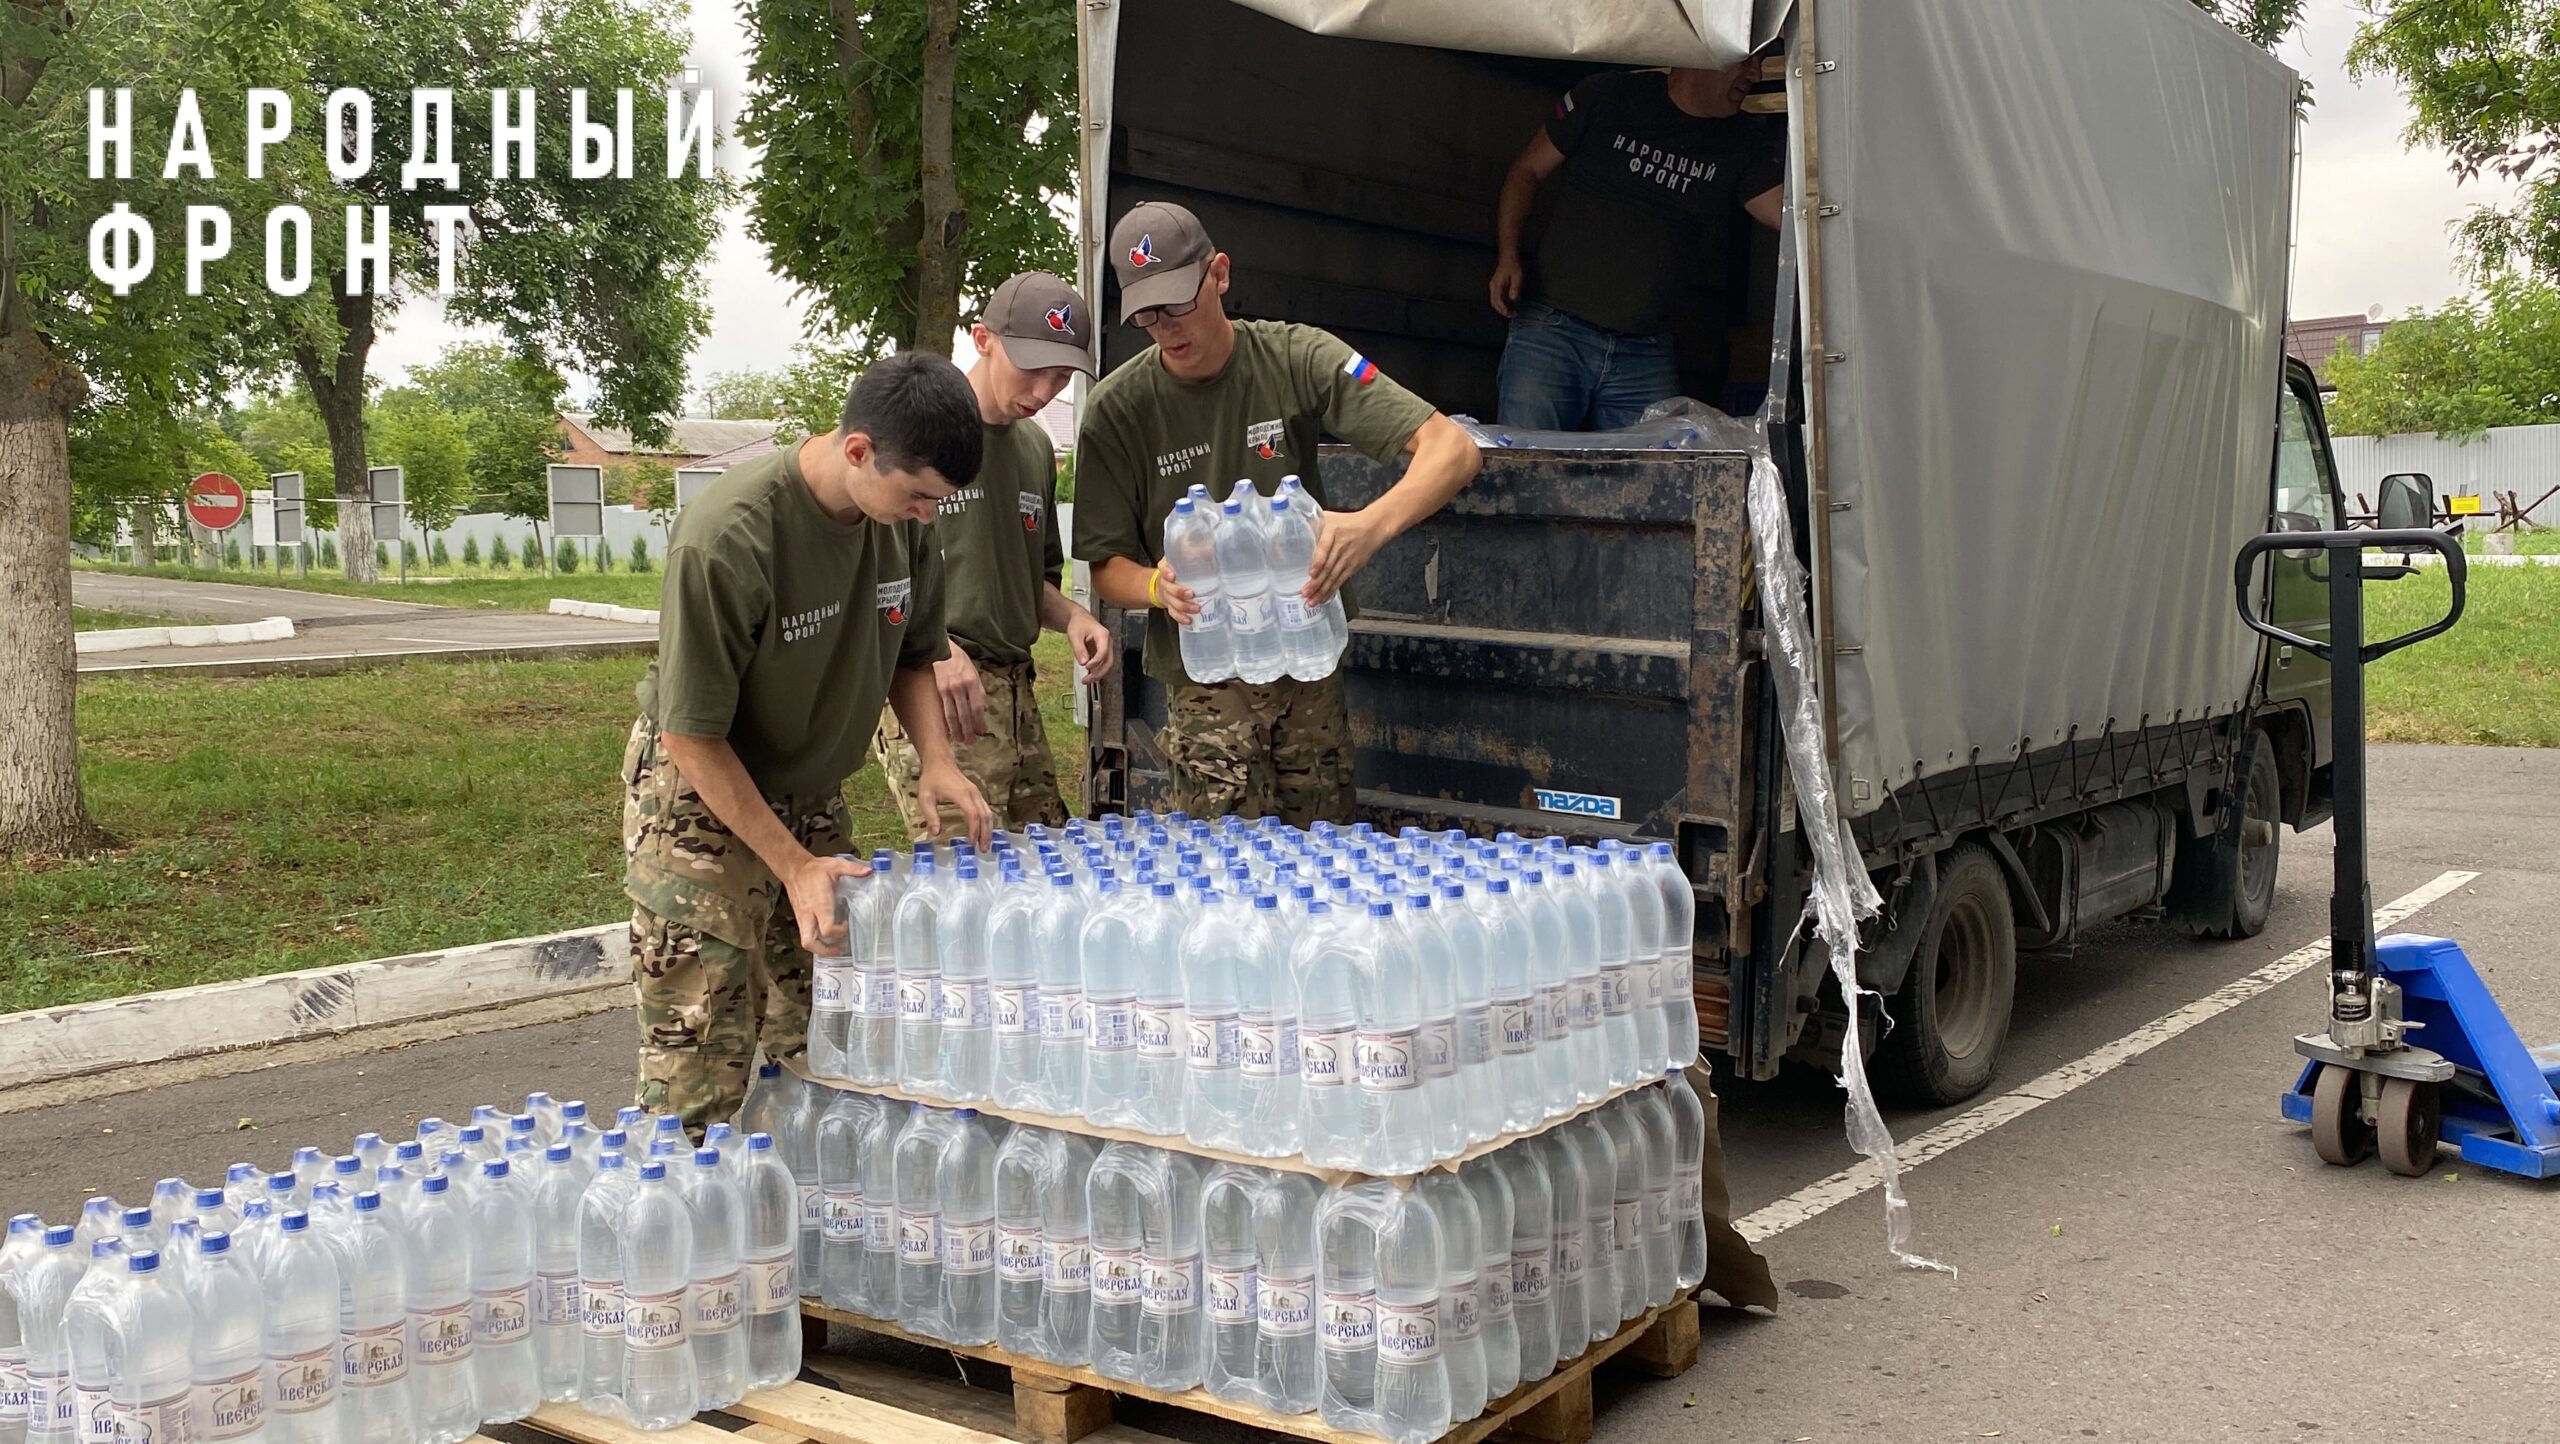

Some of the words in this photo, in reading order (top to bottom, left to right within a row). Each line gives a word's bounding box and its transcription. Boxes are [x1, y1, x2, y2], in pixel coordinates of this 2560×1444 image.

[1613, 134, 1717, 183] НАРОДНЫЙ
[1629, 157, 1691, 194] ФРОНТ
[1157, 442, 1211, 467] НАРОДНЫЙ
[1159, 459, 1192, 478] ФРОНТ
[938, 501, 966, 516] РОНТ
[781, 599, 840, 630] НАРОДНЫЙ
[783, 622, 821, 643] ФРОНТ
[1262, 1306, 1309, 1323] ВЕРСКАЯ
[1325, 1321, 1374, 1338] ВЕРСКАЯ
